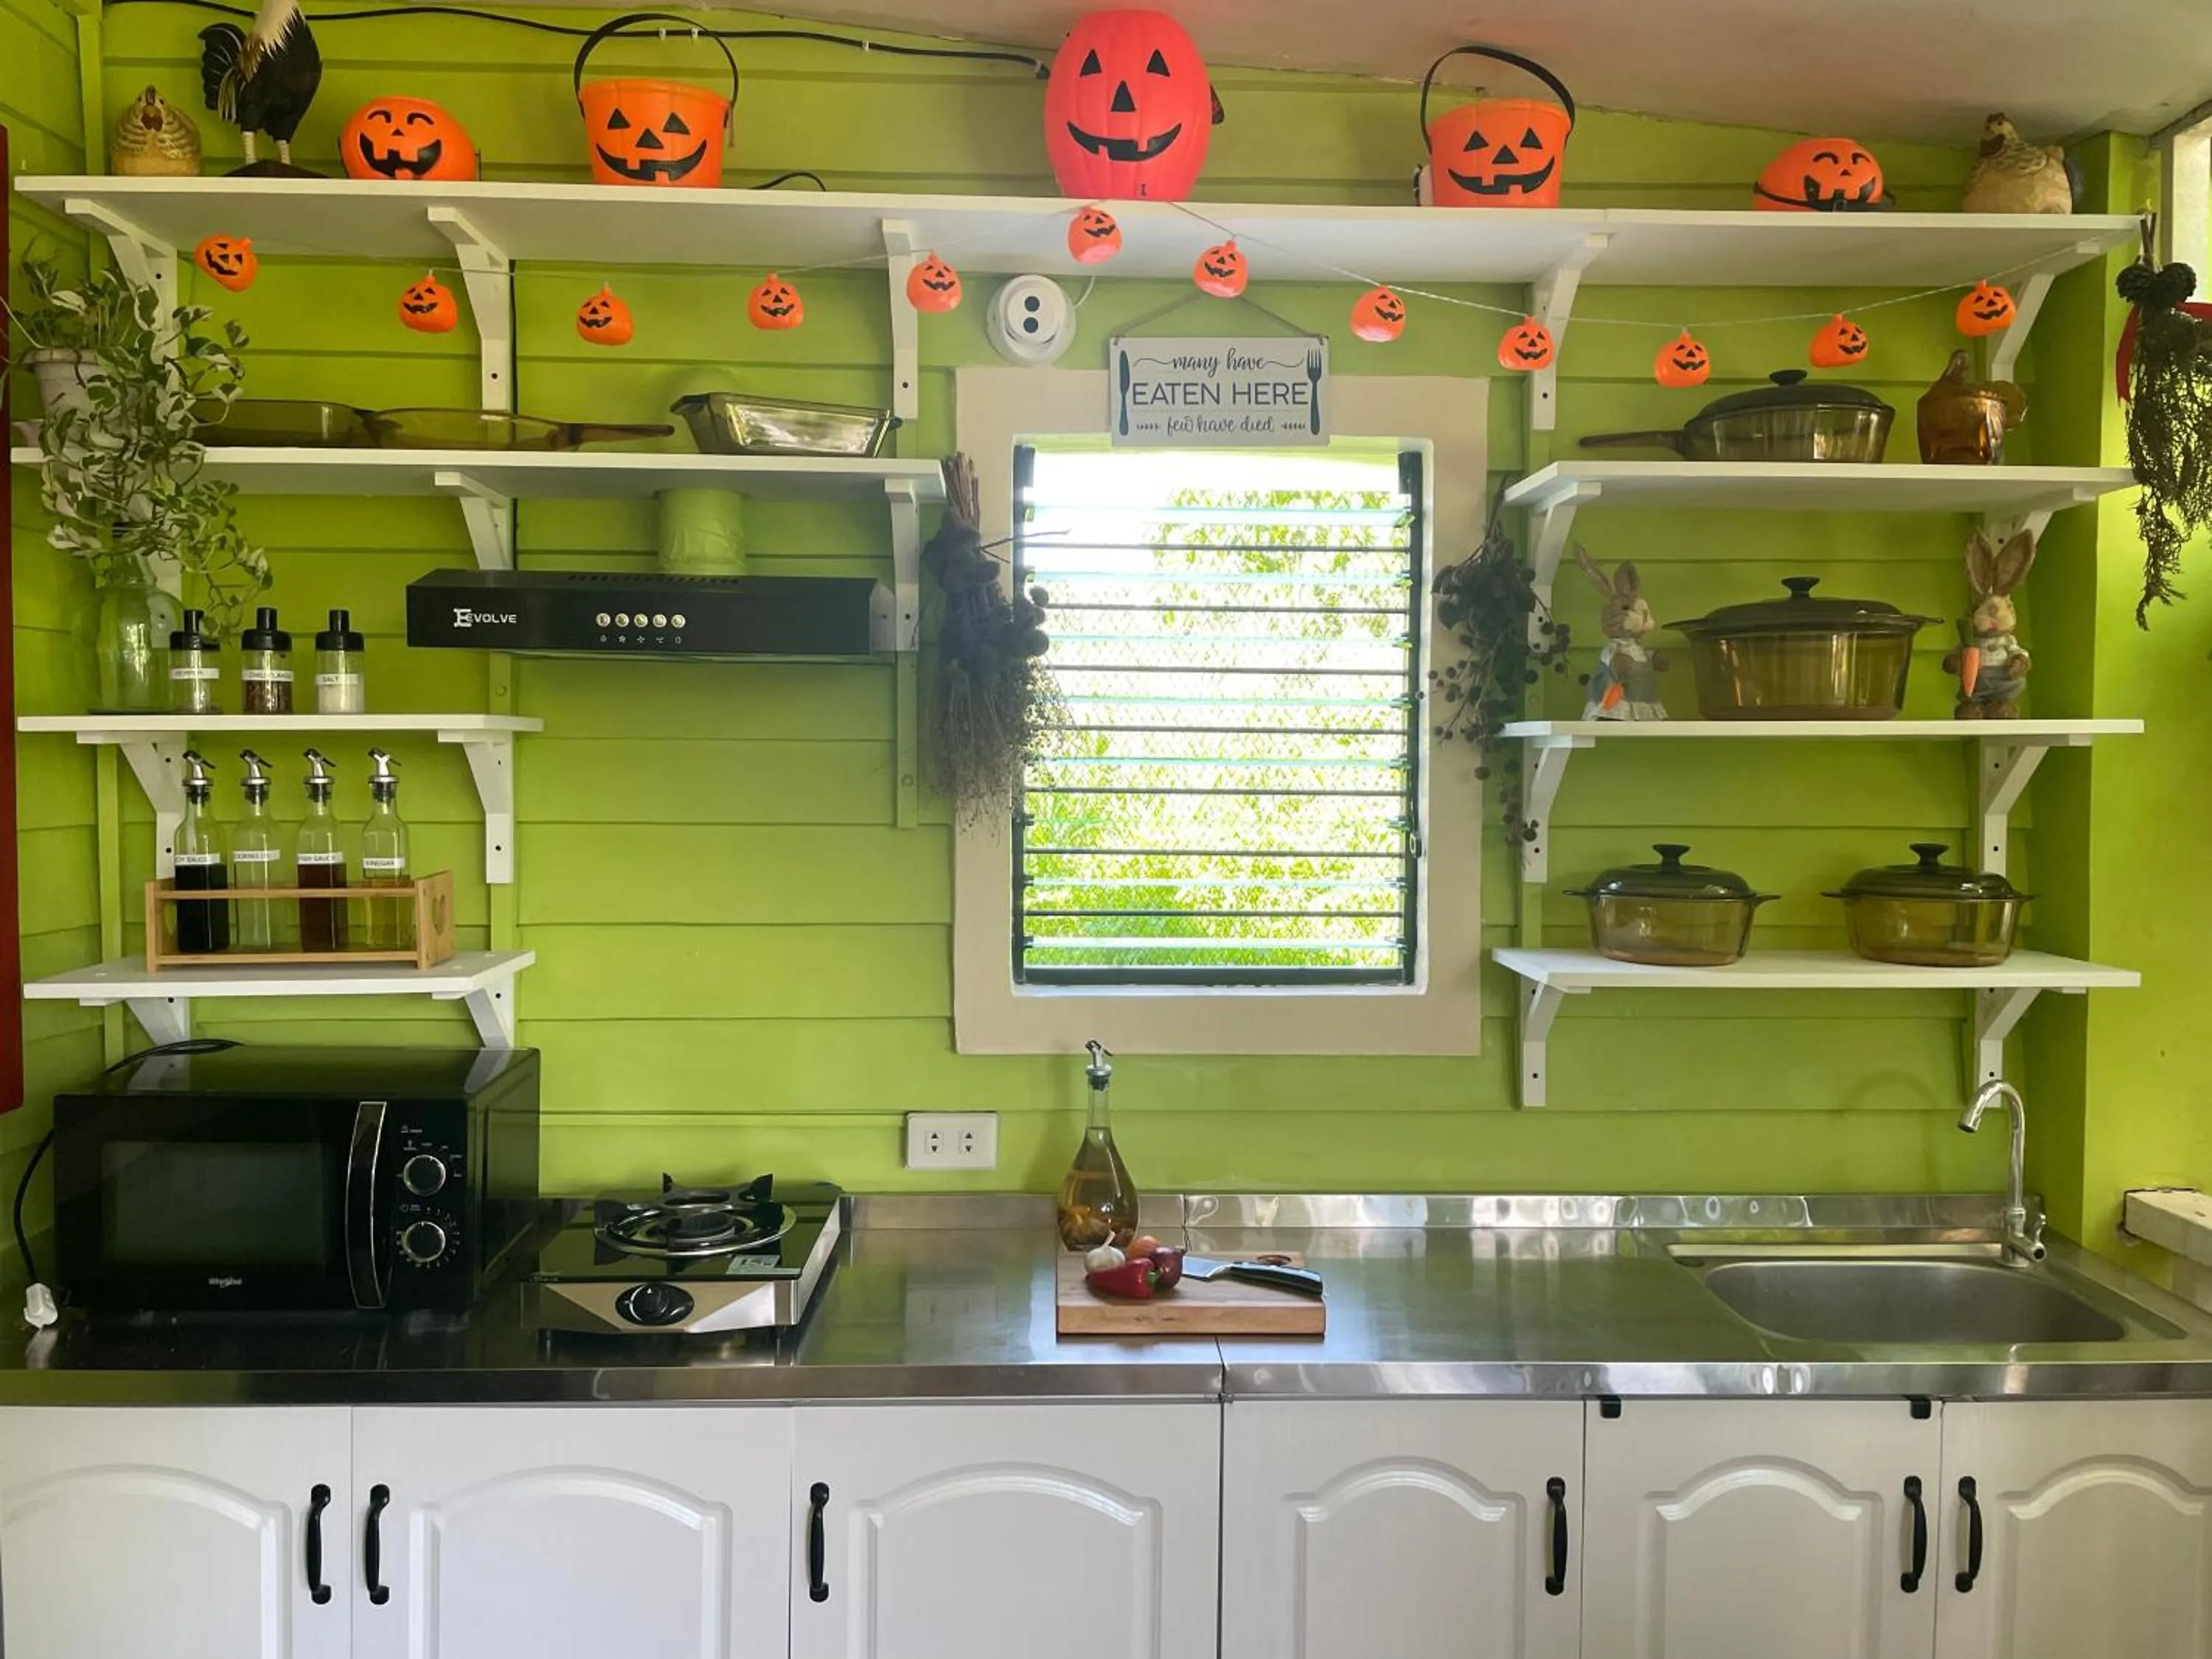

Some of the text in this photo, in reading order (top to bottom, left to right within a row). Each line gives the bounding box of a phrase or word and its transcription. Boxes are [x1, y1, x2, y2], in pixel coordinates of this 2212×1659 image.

[1172, 347, 1265, 378] many have
[1132, 382, 1309, 406] EATEN HERE
[1166, 414, 1274, 437] few have died
[453, 608, 517, 627] EVOLVE
